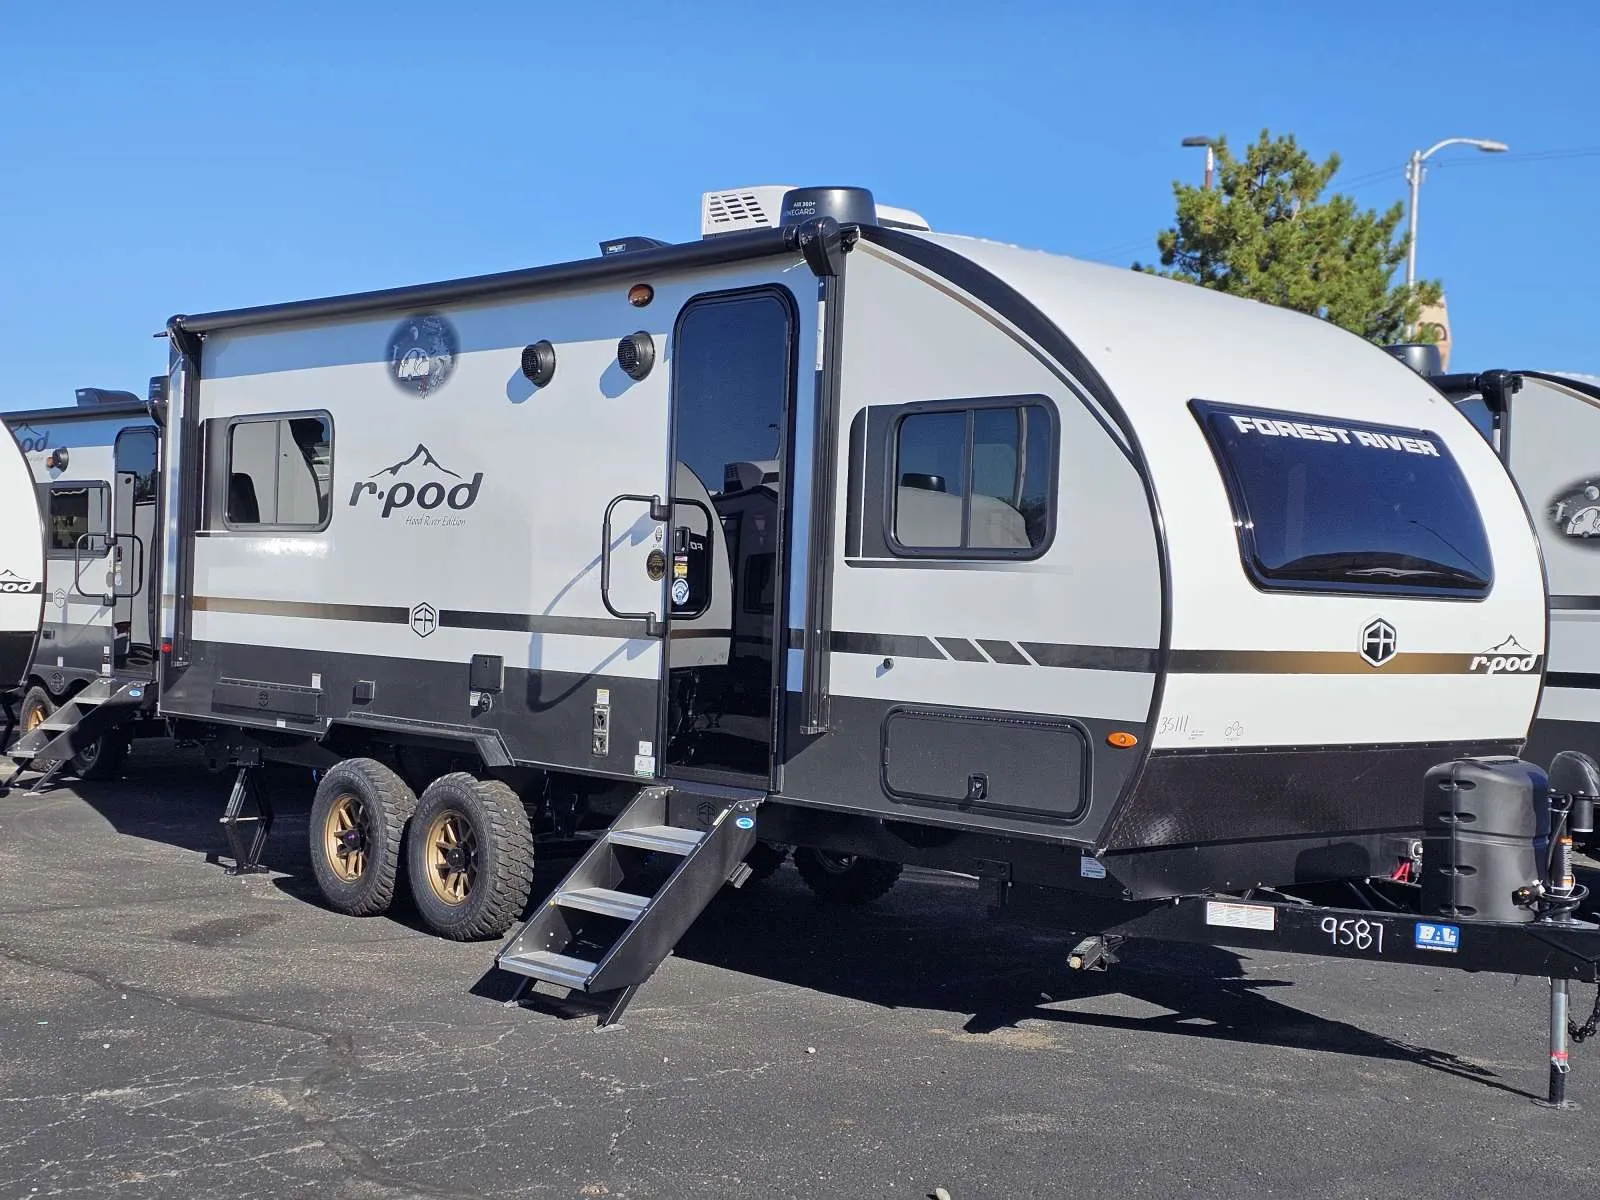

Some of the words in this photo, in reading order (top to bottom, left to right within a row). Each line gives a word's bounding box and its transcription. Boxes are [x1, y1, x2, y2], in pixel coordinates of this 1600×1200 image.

[1229, 415, 1351, 444] FOREST
[1352, 430, 1440, 457] RIVER
[1321, 917, 1383, 953] 9587
